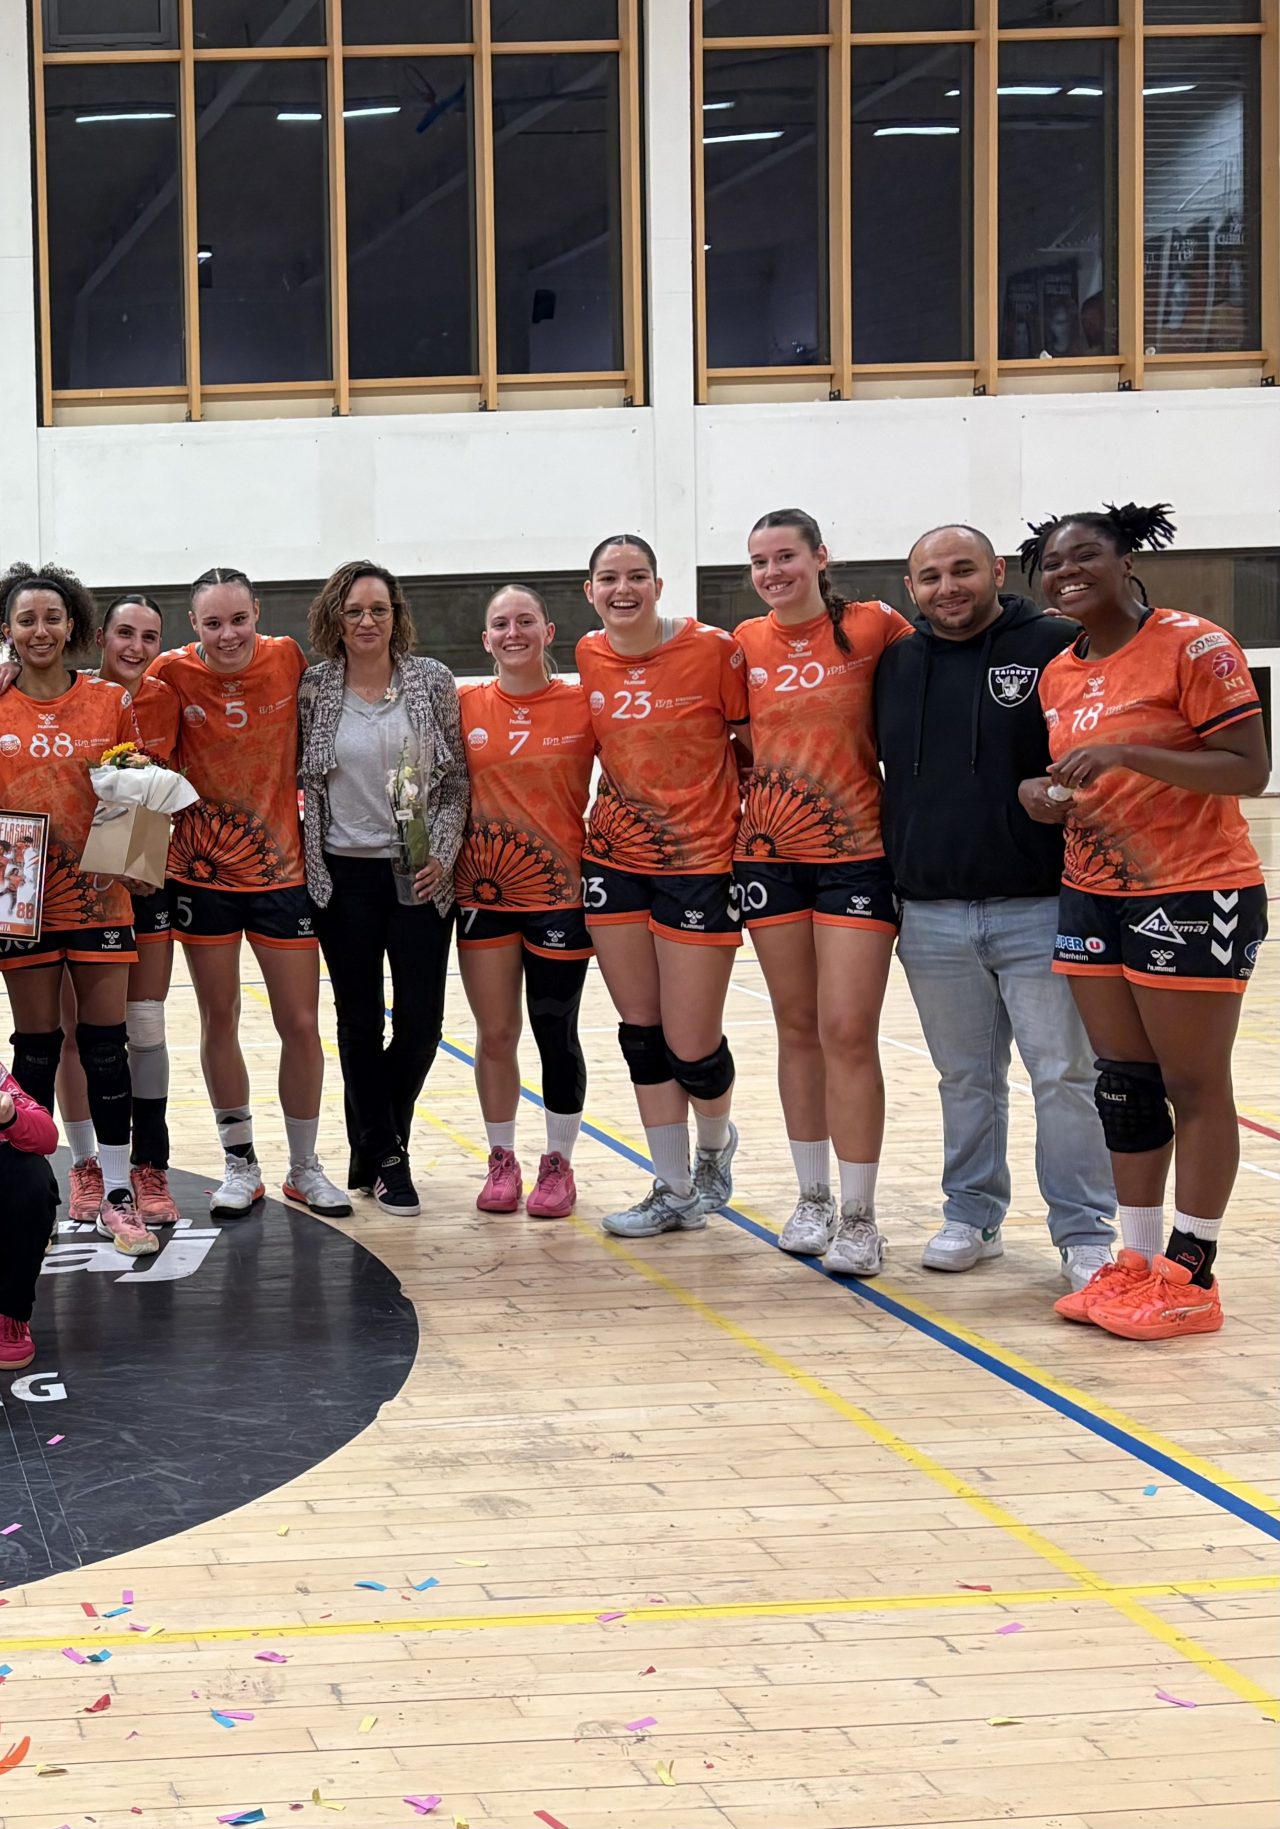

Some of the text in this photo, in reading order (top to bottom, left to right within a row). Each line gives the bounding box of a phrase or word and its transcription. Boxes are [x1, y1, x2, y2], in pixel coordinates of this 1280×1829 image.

[775, 661, 825, 692] 20
[225, 701, 248, 728] 5
[611, 690, 652, 719] 23
[1072, 702, 1104, 734] 18
[29, 733, 74, 758] 88
[508, 731, 530, 756] 7
[737, 881, 768, 911] 20
[176, 896, 193, 927] 5
[461, 907, 478, 934] 7
[1147, 963, 1176, 973] hummel
